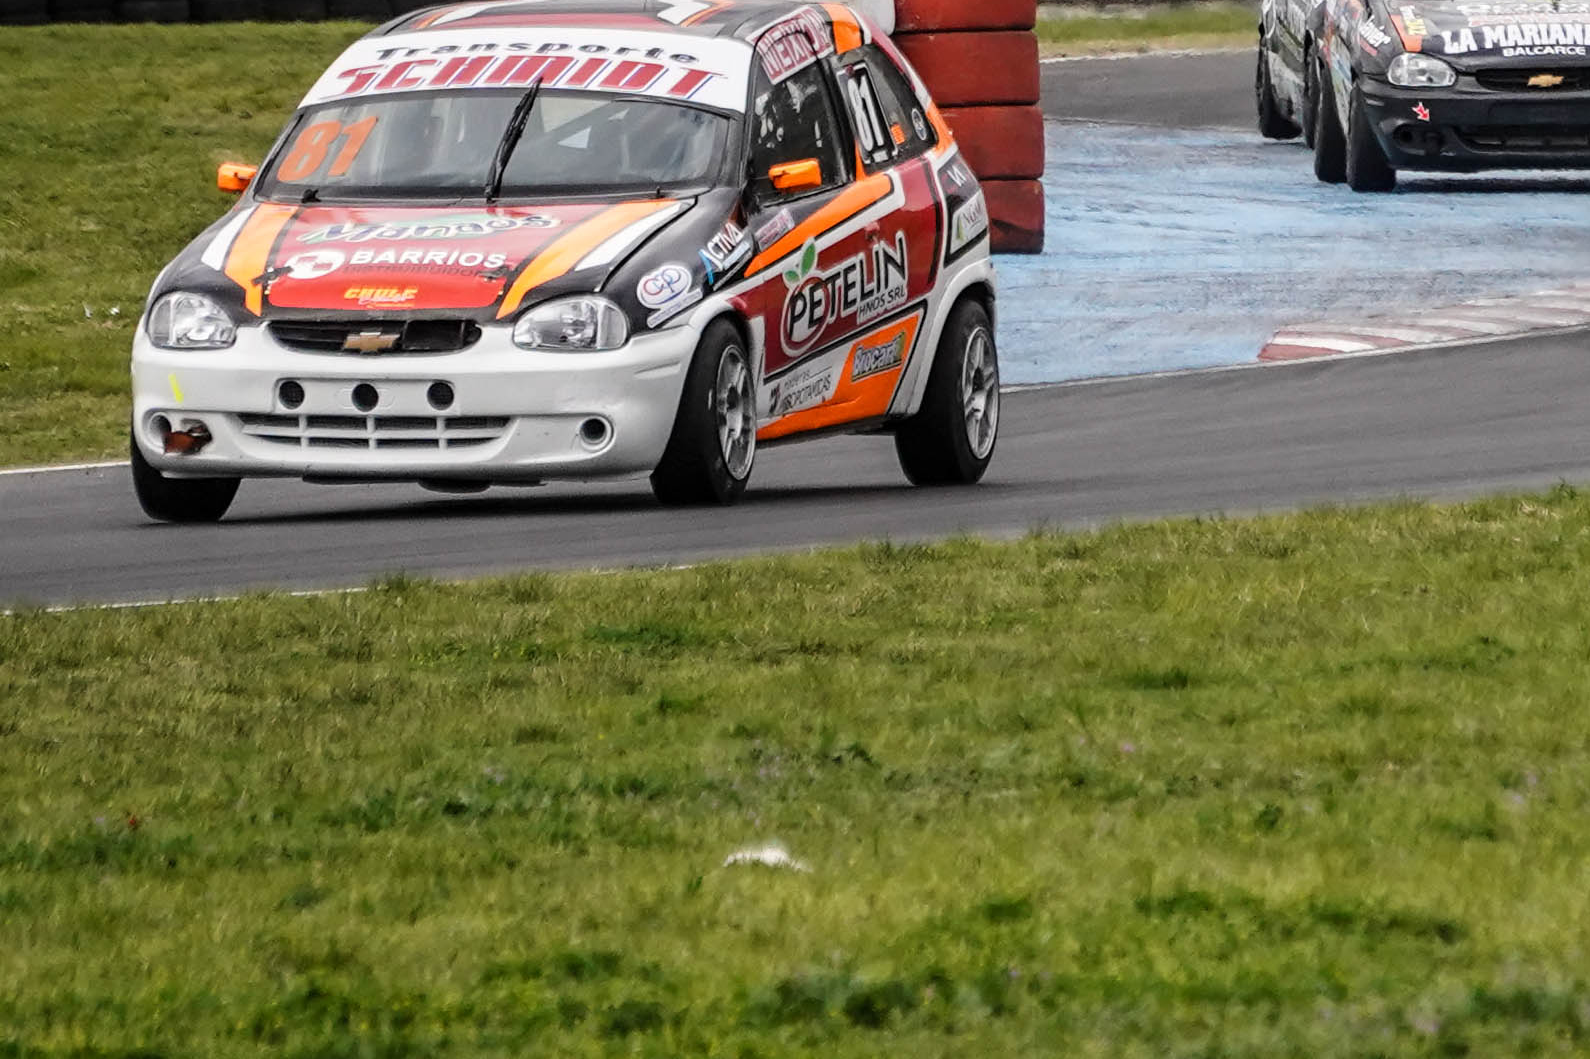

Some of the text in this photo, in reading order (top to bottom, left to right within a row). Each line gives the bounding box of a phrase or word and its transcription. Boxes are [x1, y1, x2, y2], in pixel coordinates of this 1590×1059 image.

[376, 41, 699, 64] Transporte
[1442, 25, 1478, 54] LA
[1503, 46, 1587, 58] BALCARCE
[338, 54, 727, 101] SCHMIDT
[848, 74, 884, 152] 81
[277, 115, 379, 183] 81
[349, 248, 507, 269] BARRIOS
[788, 228, 907, 342] PETELIN
[859, 285, 906, 318] HNOS SRL
